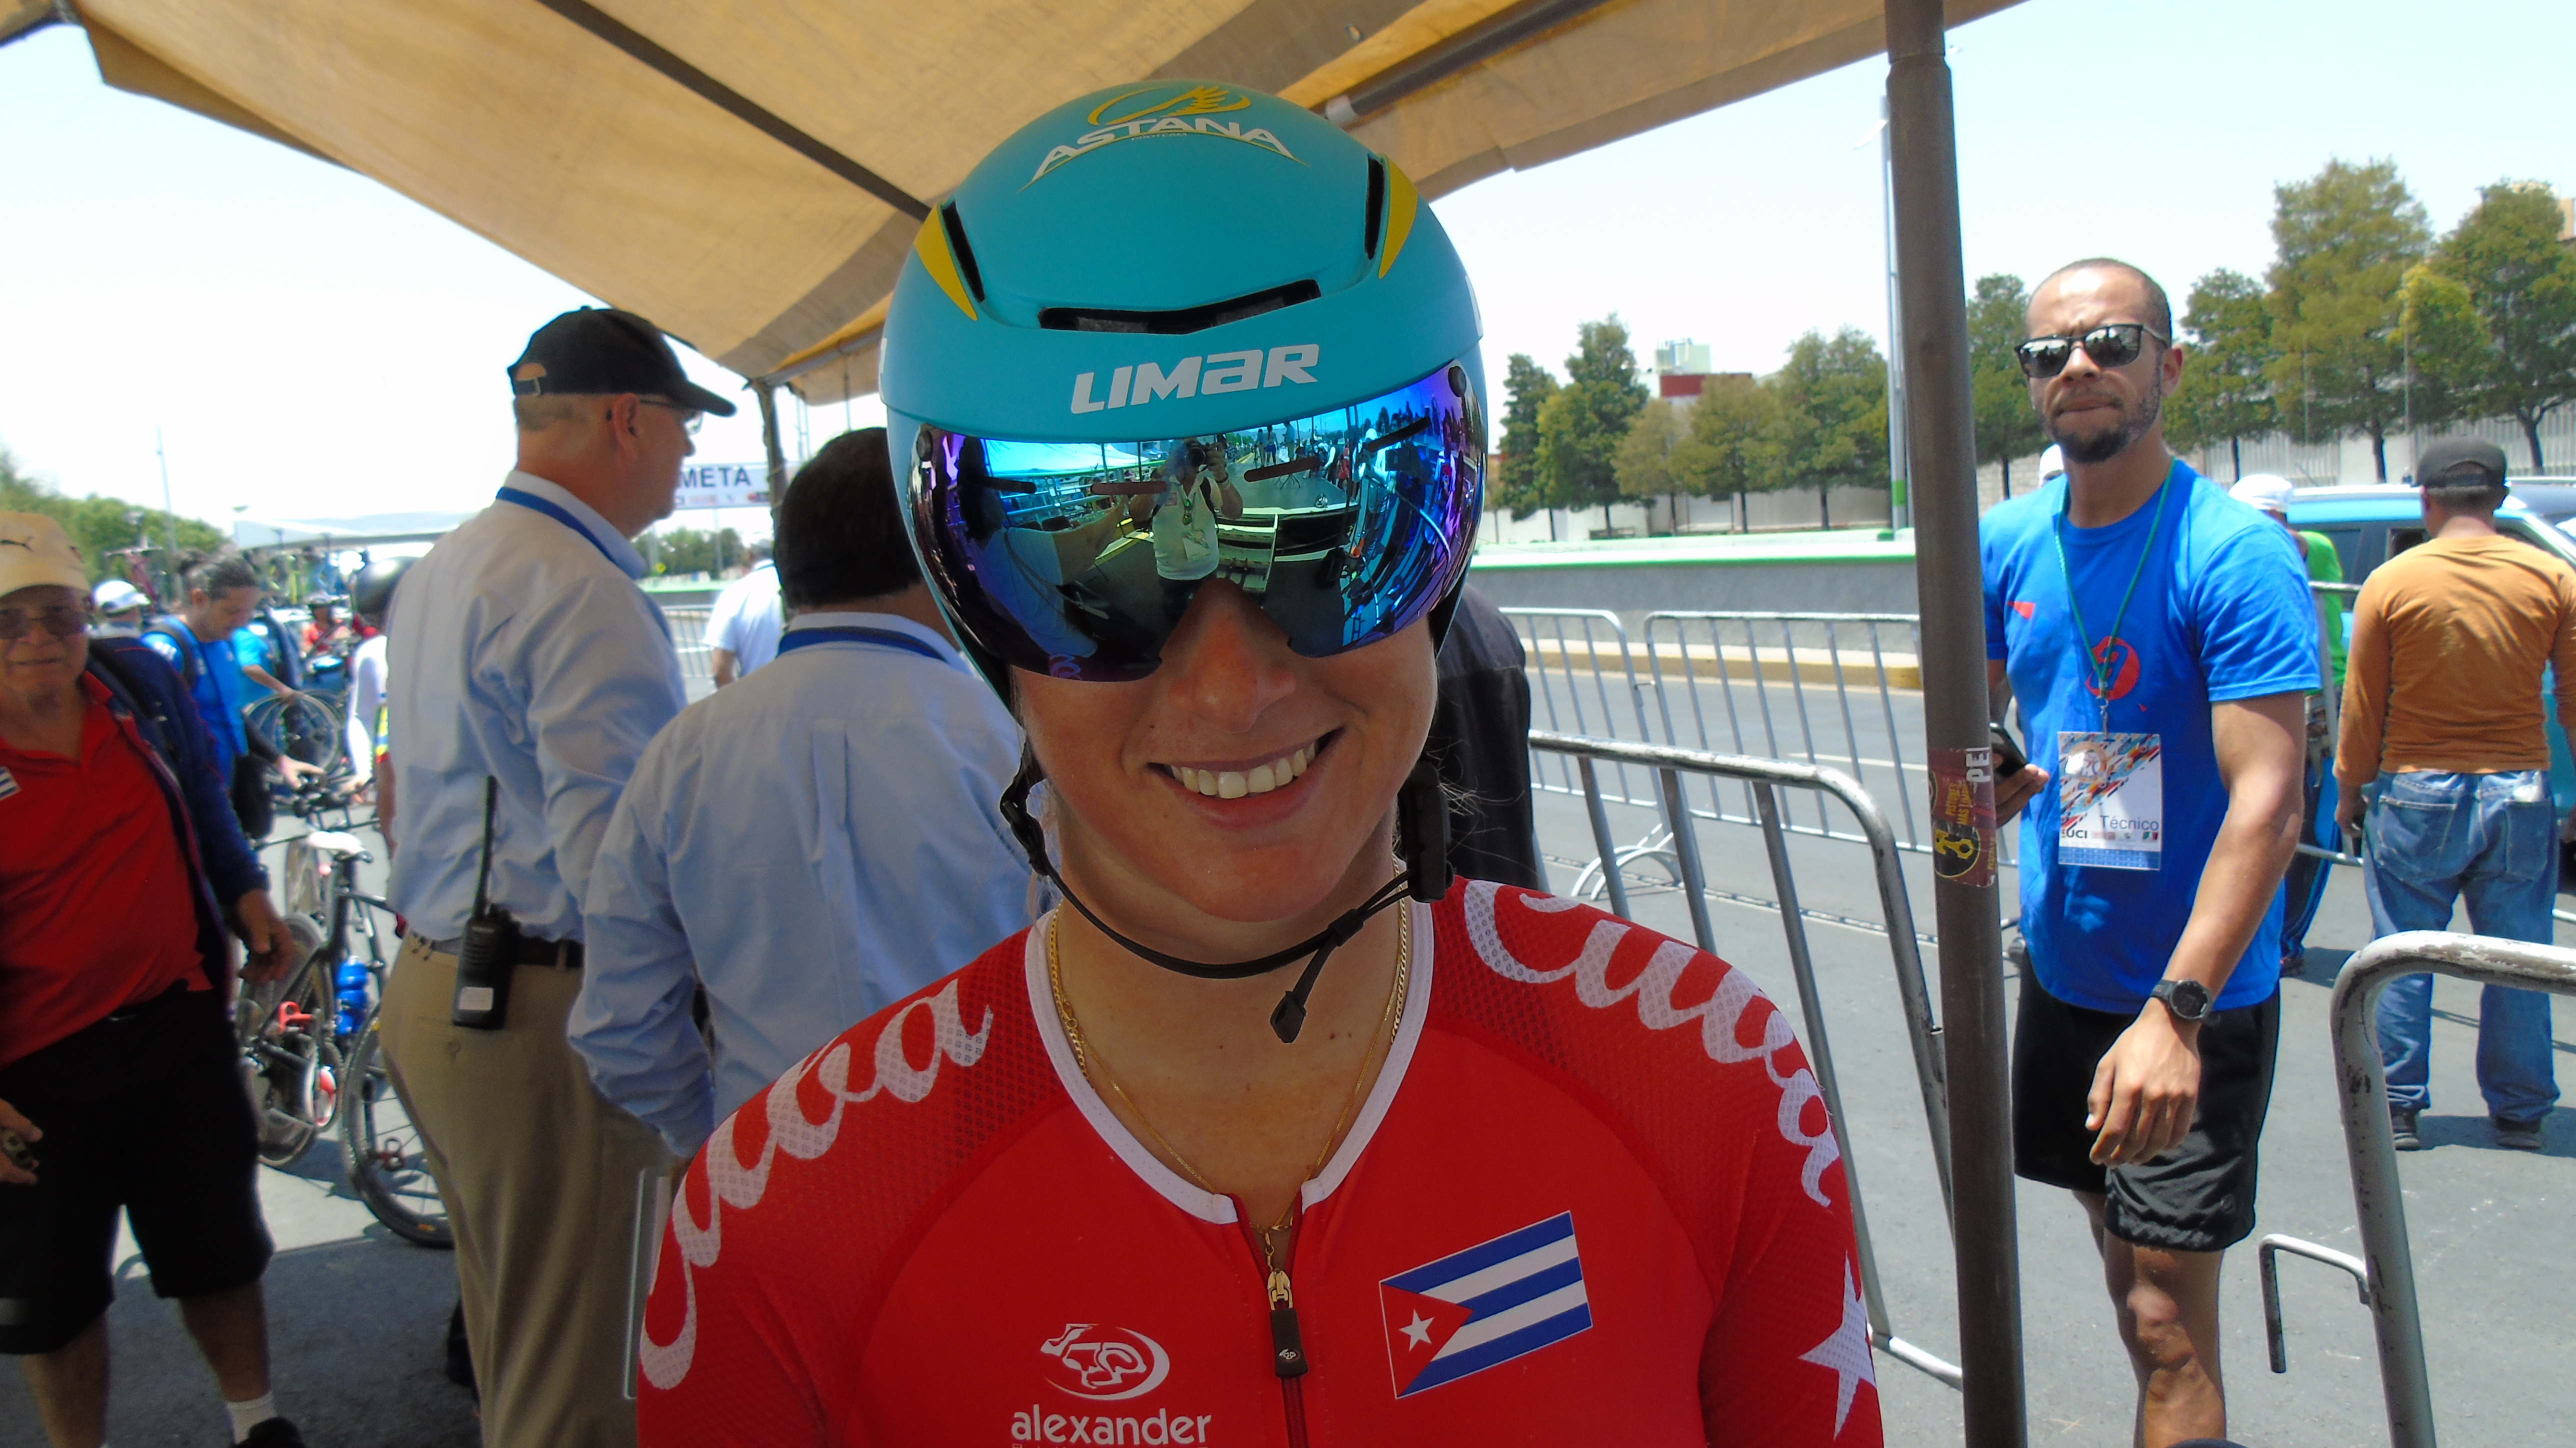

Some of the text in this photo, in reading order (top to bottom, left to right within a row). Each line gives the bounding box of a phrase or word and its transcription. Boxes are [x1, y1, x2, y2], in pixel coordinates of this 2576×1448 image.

[1031, 116, 1295, 183] ASTANA
[679, 466, 752, 488] META
[2100, 815, 2160, 831] Técnico
[2066, 830, 2088, 839] UCI
[1011, 1404, 1212, 1446] alexander
